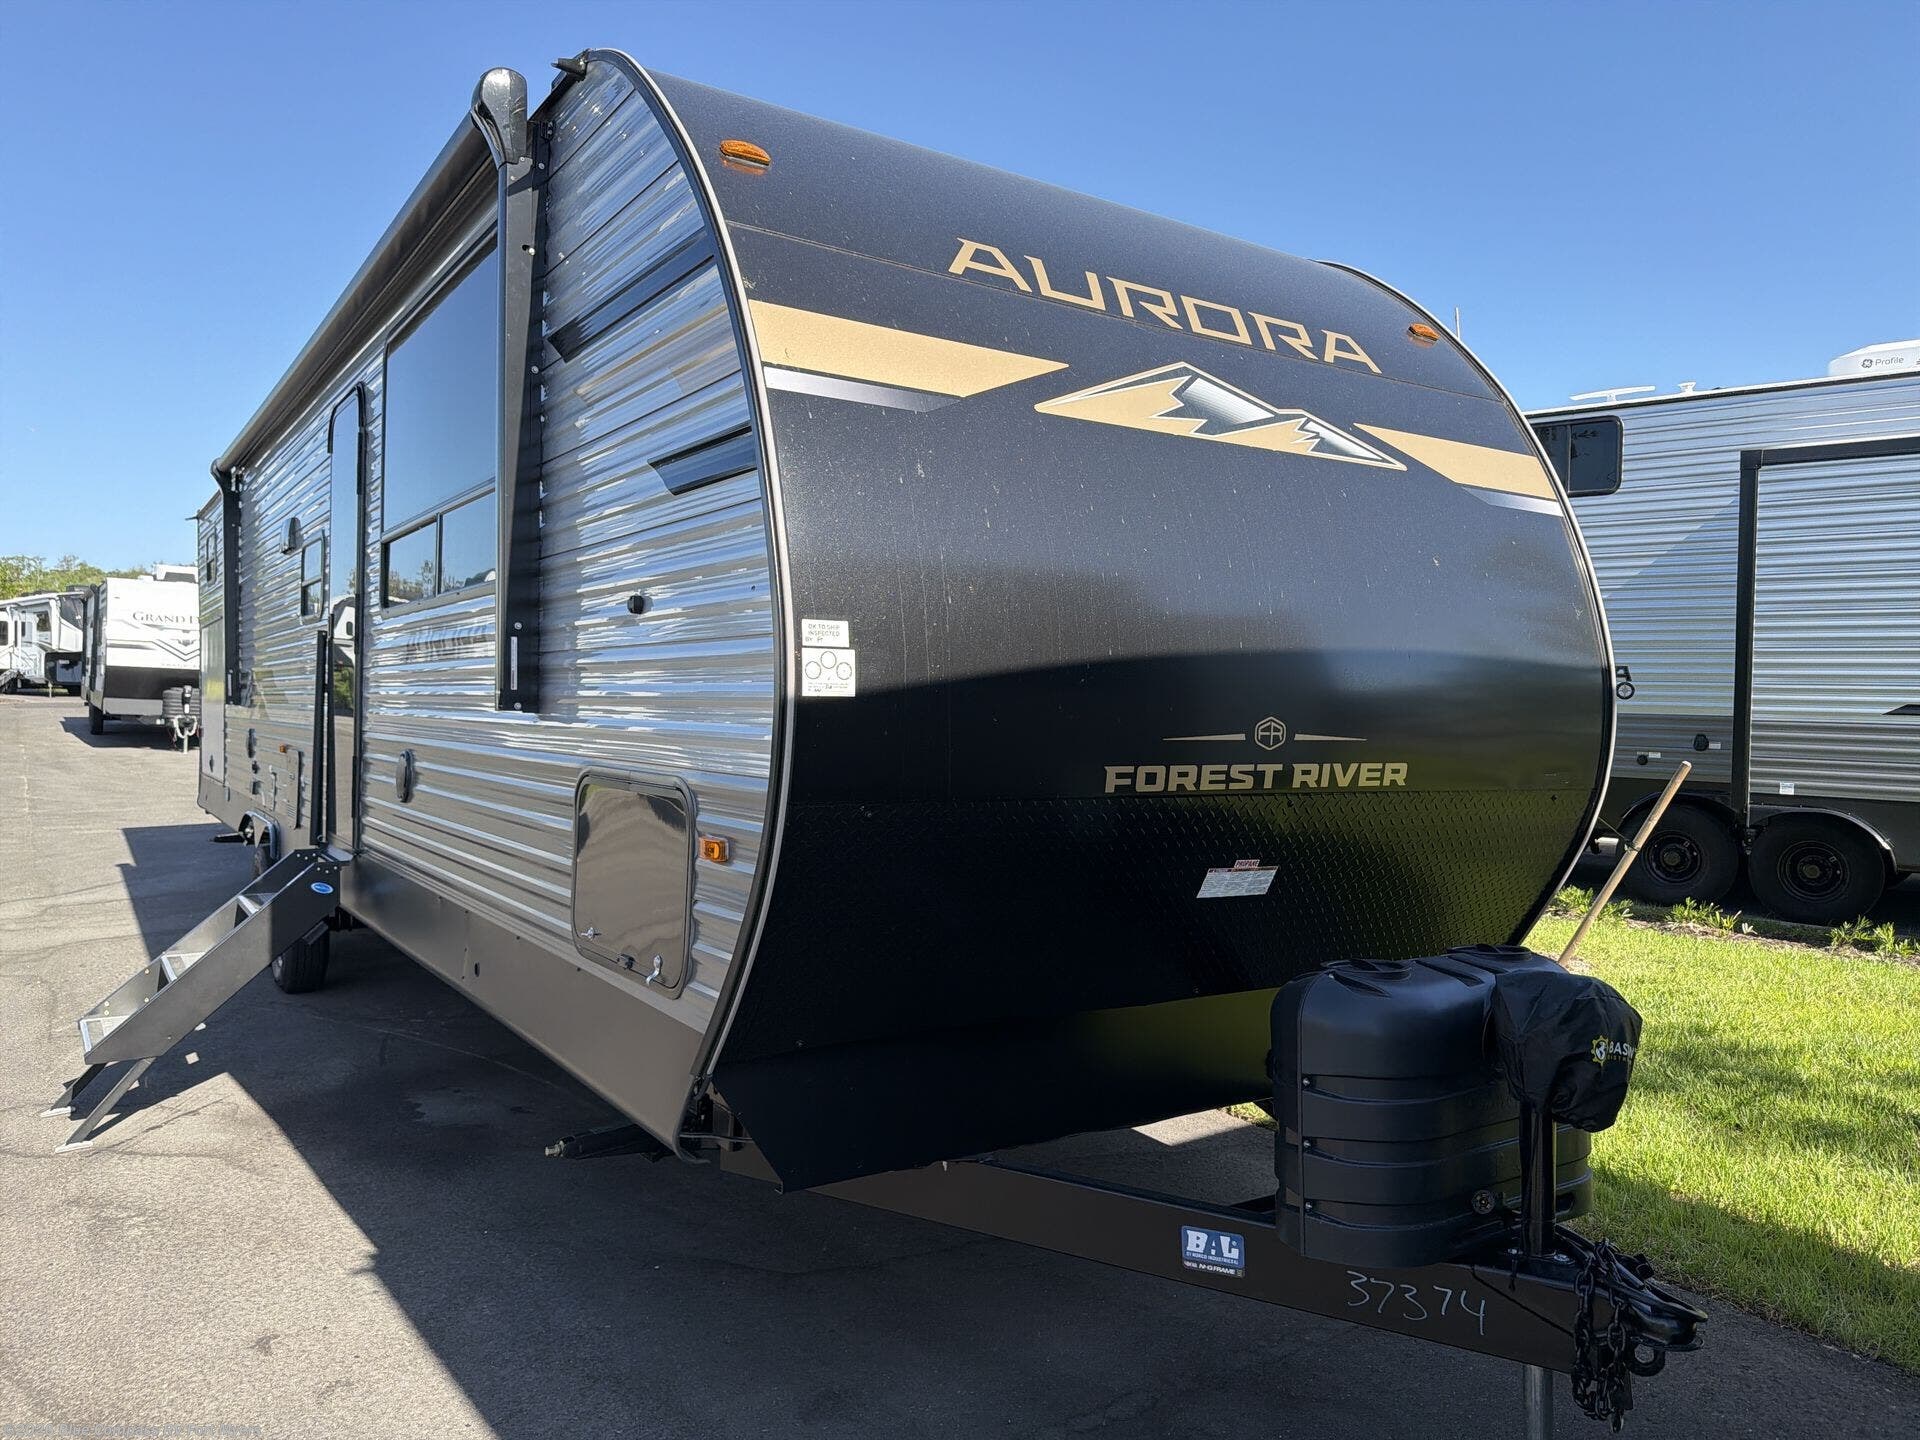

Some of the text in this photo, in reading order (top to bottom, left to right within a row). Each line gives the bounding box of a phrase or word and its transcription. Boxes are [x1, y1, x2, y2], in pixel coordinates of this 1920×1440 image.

[948, 237, 1383, 374] AURORA
[1875, 357, 1904, 366] Profile
[132, 610, 185, 623] GRAND
[1104, 762, 1409, 793] FOREST RIVER
[1186, 1230, 1239, 1259] BAL
[1347, 1270, 1485, 1336] 37374
